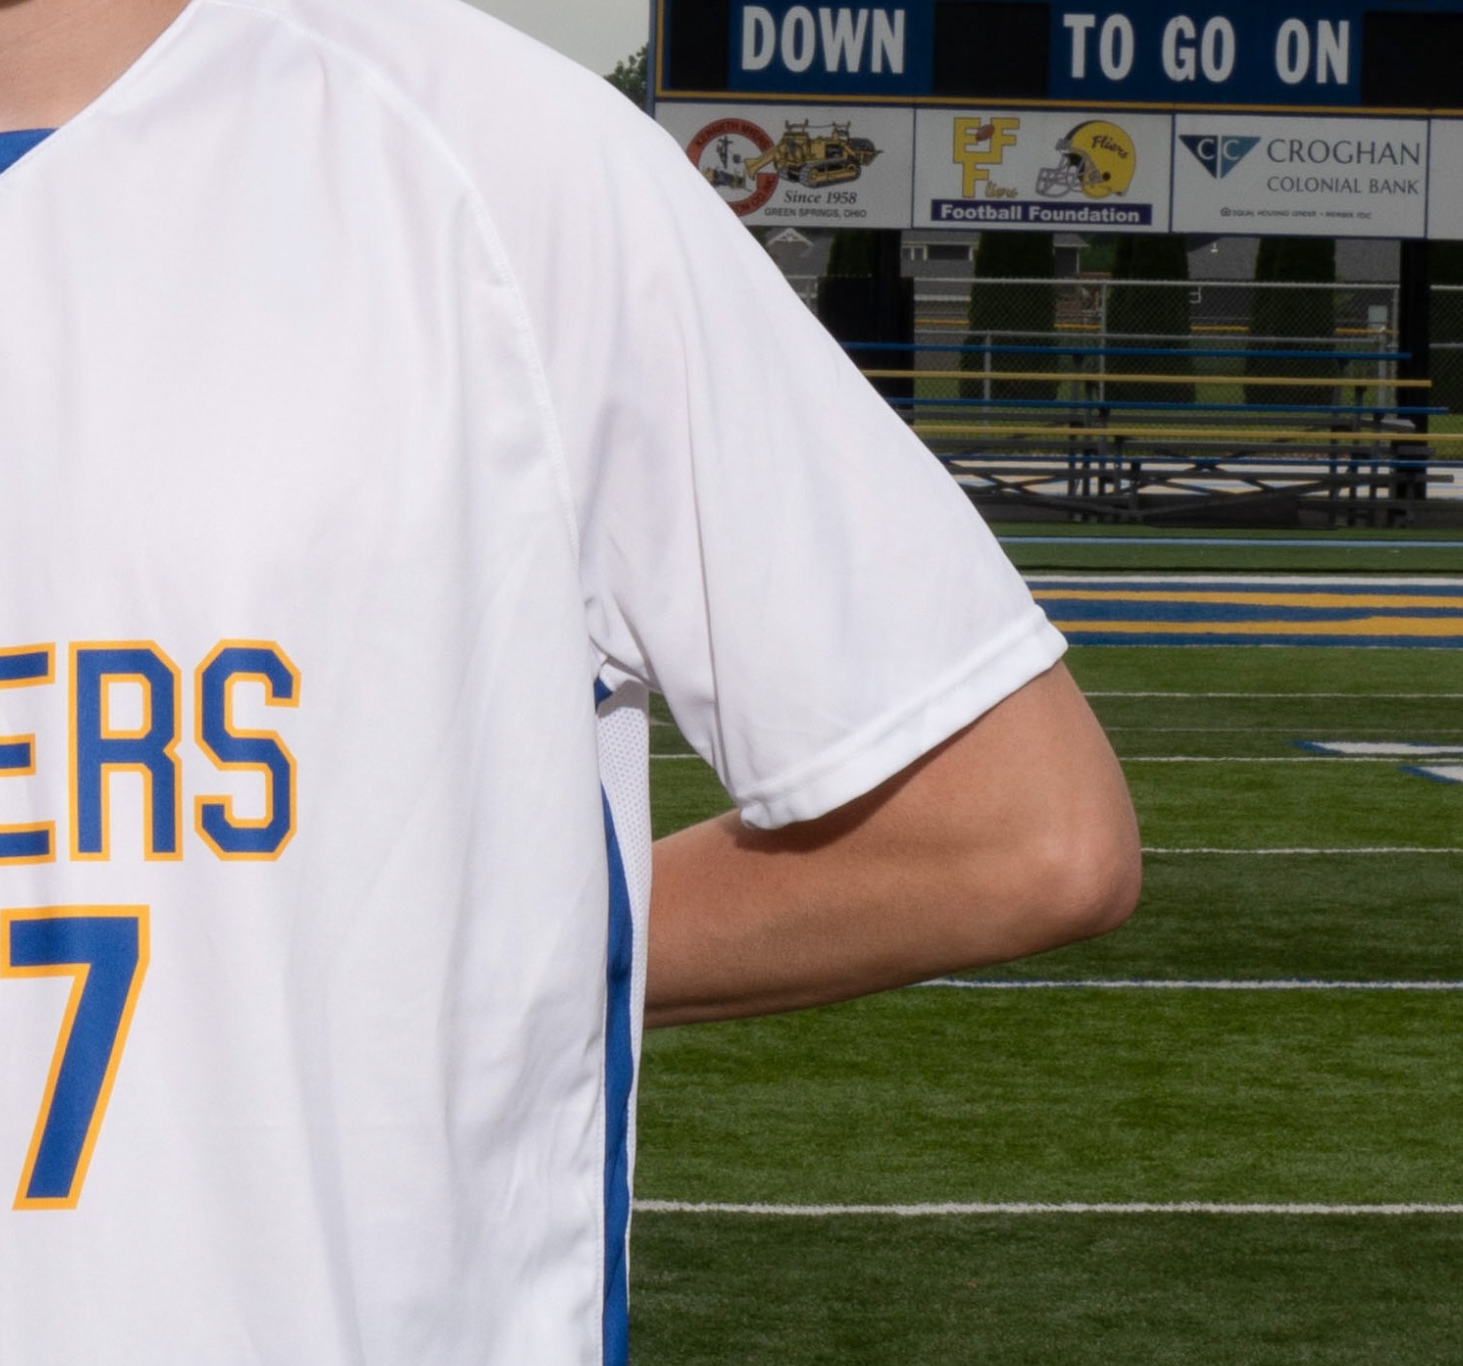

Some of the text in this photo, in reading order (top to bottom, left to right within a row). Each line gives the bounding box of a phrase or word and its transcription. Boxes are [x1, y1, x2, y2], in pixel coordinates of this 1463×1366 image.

[741, 6, 906, 74] DOWN
[1063, 14, 1351, 85] TO GO ON
[1091, 135, 1129, 159] Fliers
[1267, 138, 1420, 165] CROGHAN
[1267, 176, 1419, 195] COLONIAL BANK
[784, 191, 858, 205] Since 1958
[764, 208, 796, 217] GREEN
[845, 210, 867, 218] OHIO
[941, 203, 1141, 223] Football Foundation
